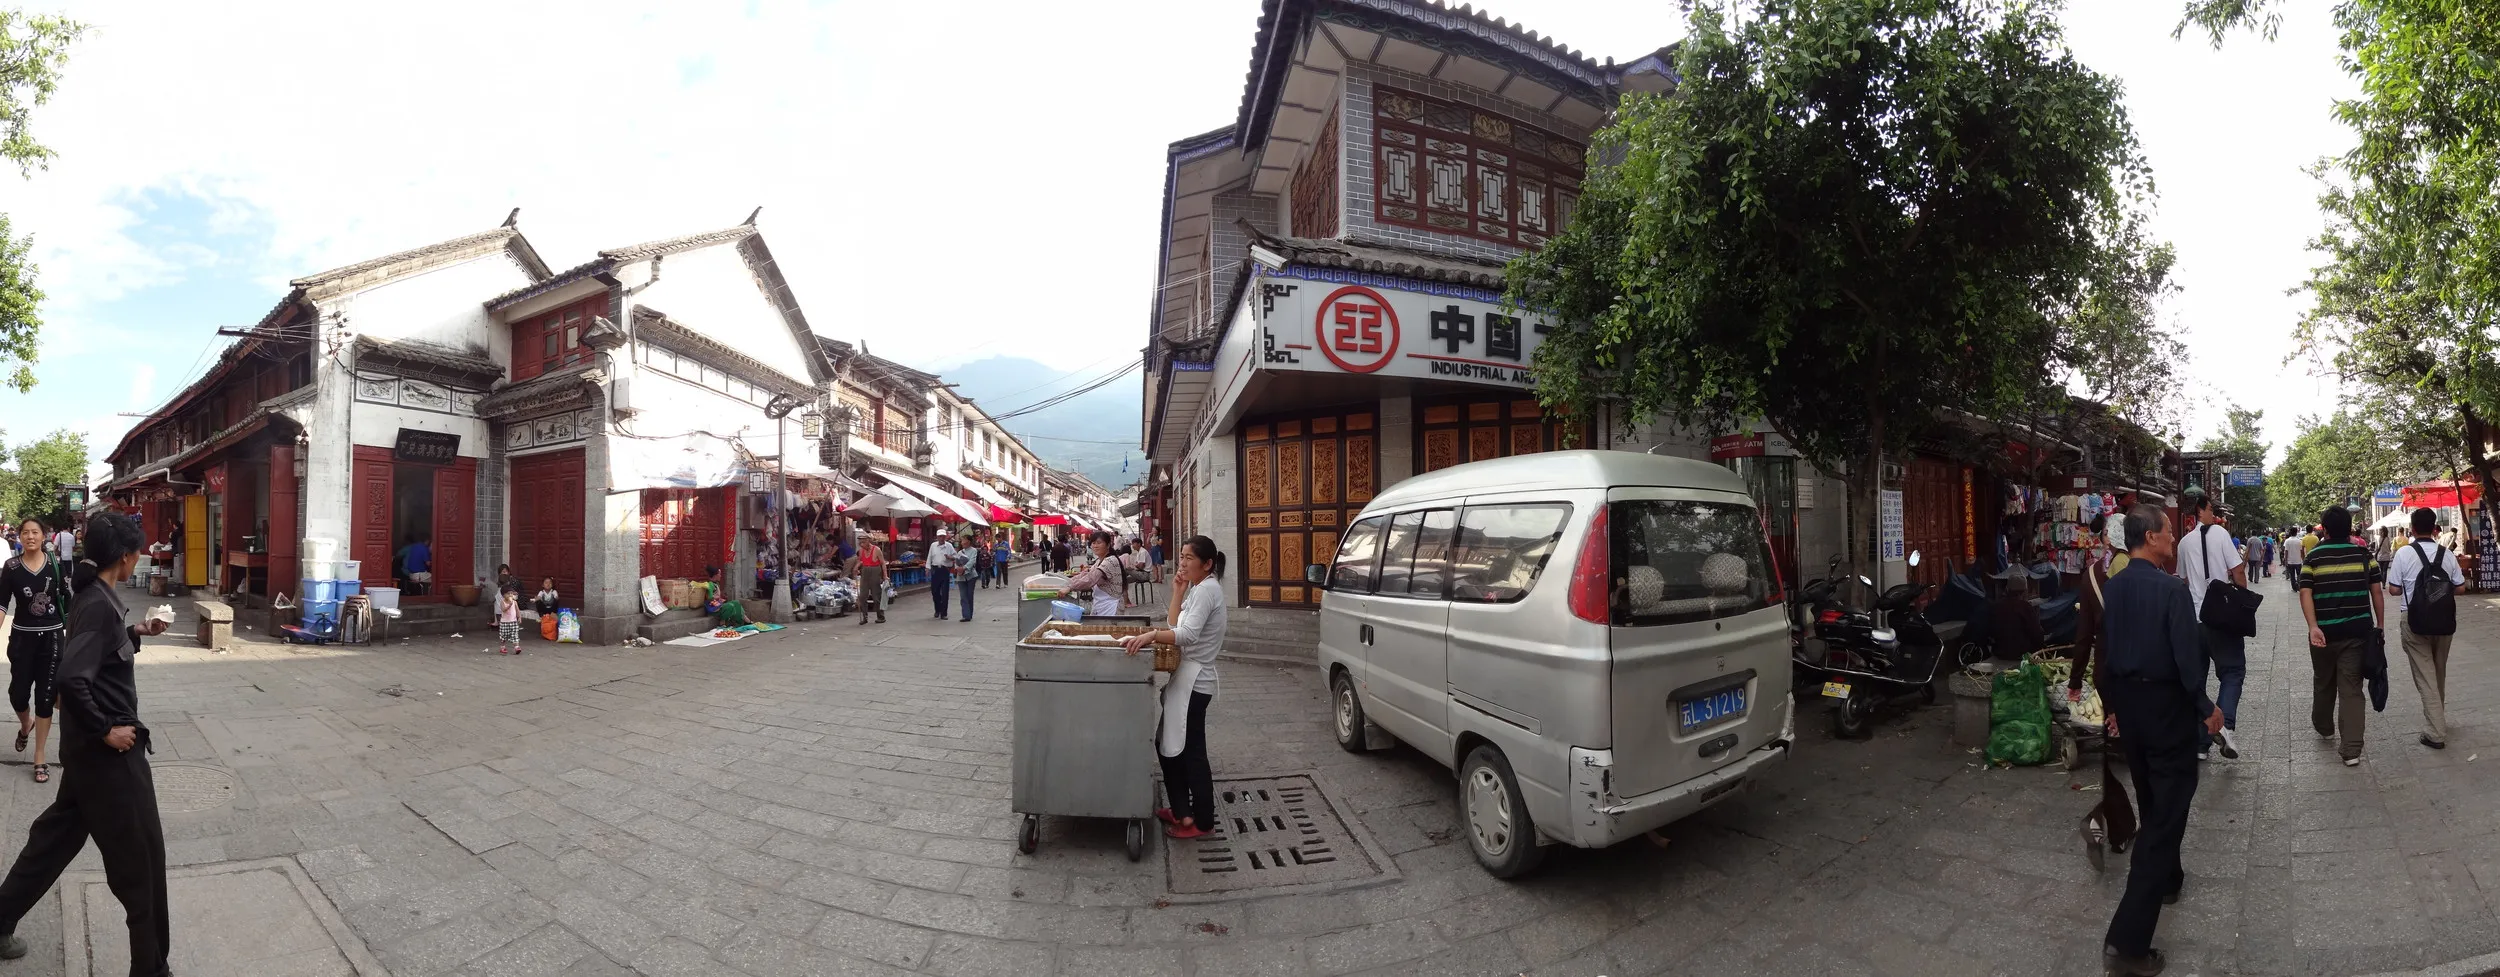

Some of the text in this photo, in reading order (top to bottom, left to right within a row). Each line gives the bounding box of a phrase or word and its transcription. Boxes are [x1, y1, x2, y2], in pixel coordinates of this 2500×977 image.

[1431, 305, 1556, 361] 中国
[1431, 361, 1508, 381] INDIUSTRIAL
[1884, 538, 1904, 559] 刻章
[1703, 687, 1745, 720] 31219
